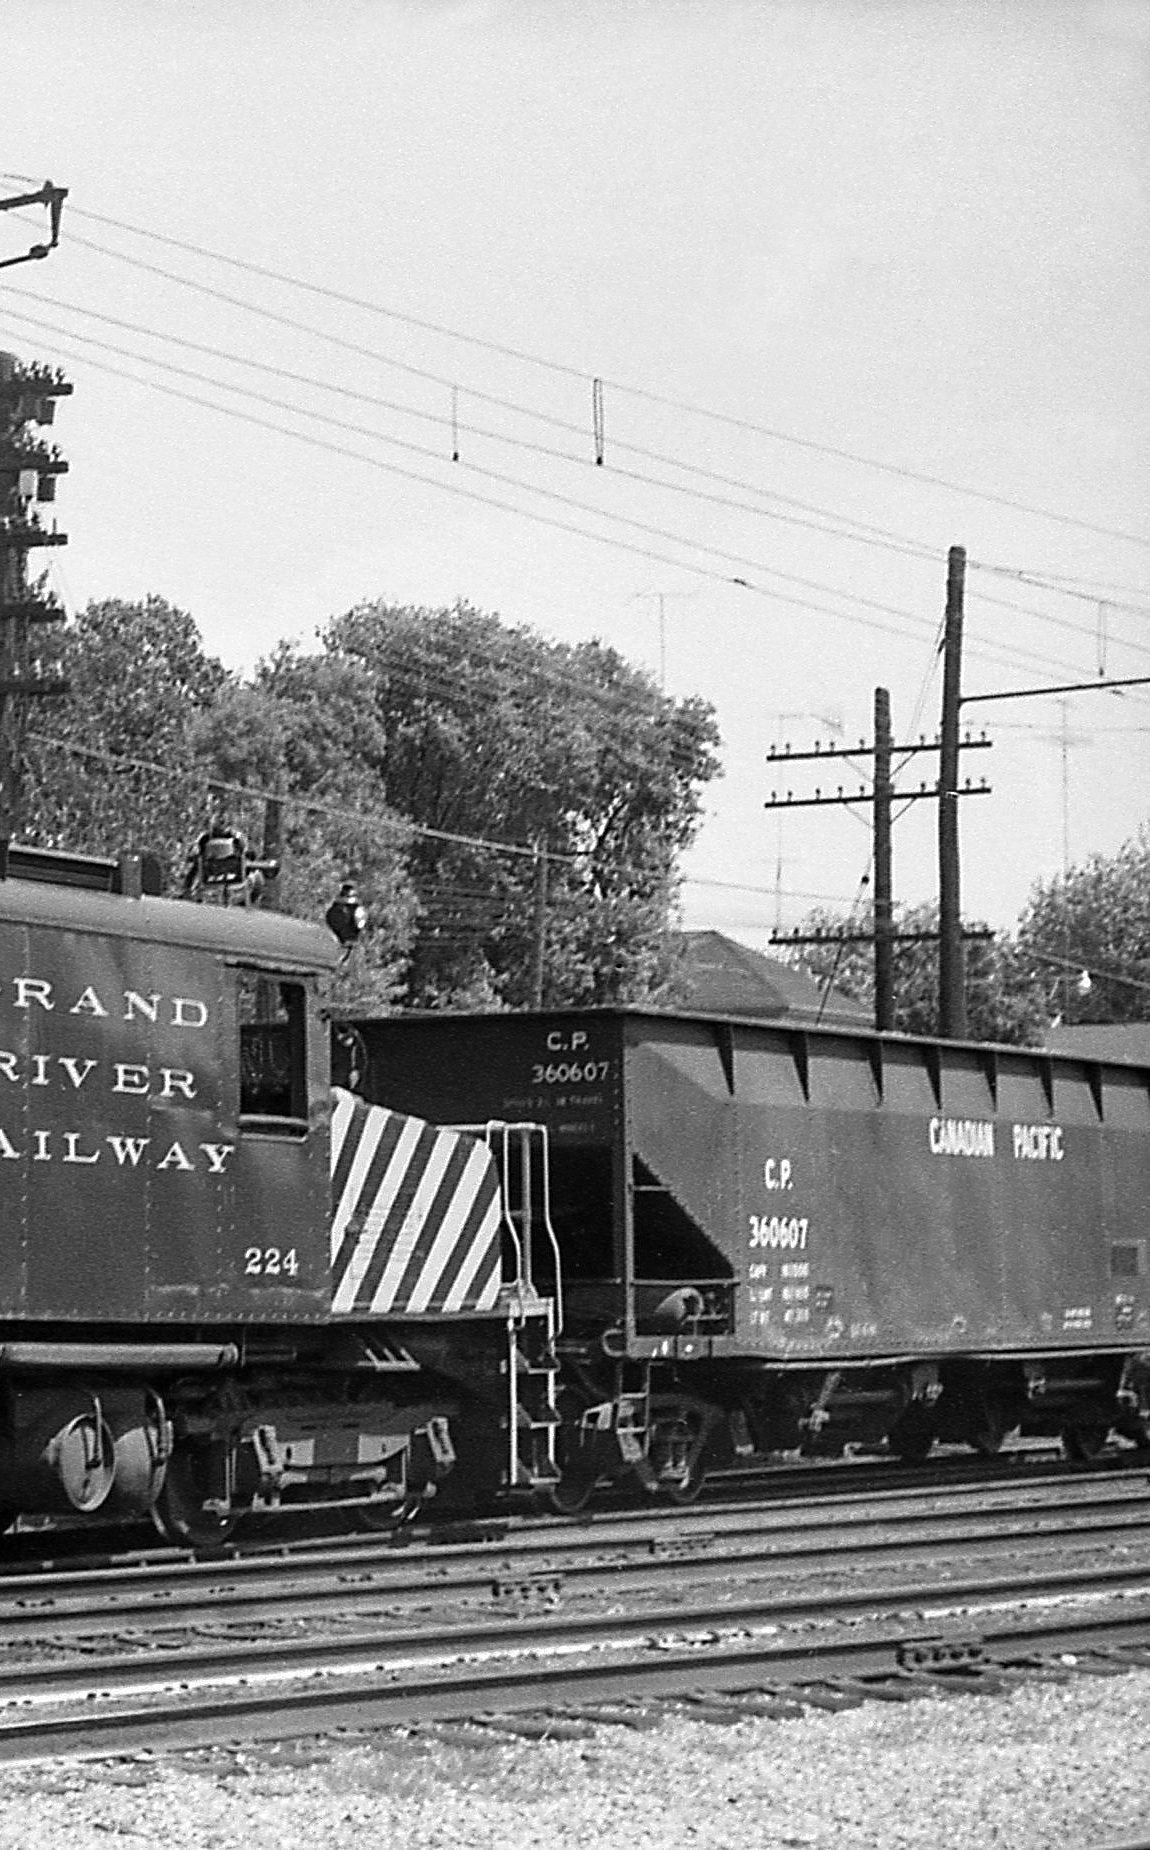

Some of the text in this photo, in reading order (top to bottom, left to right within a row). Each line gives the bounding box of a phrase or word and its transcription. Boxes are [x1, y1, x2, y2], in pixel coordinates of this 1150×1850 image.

[546, 1030, 590, 1051] C.P.
[531, 1061, 609, 1084] 360607
[764, 1157, 794, 1190] C.P.
[749, 1215, 809, 1250] 360607
[244, 1247, 299, 1276] 224
